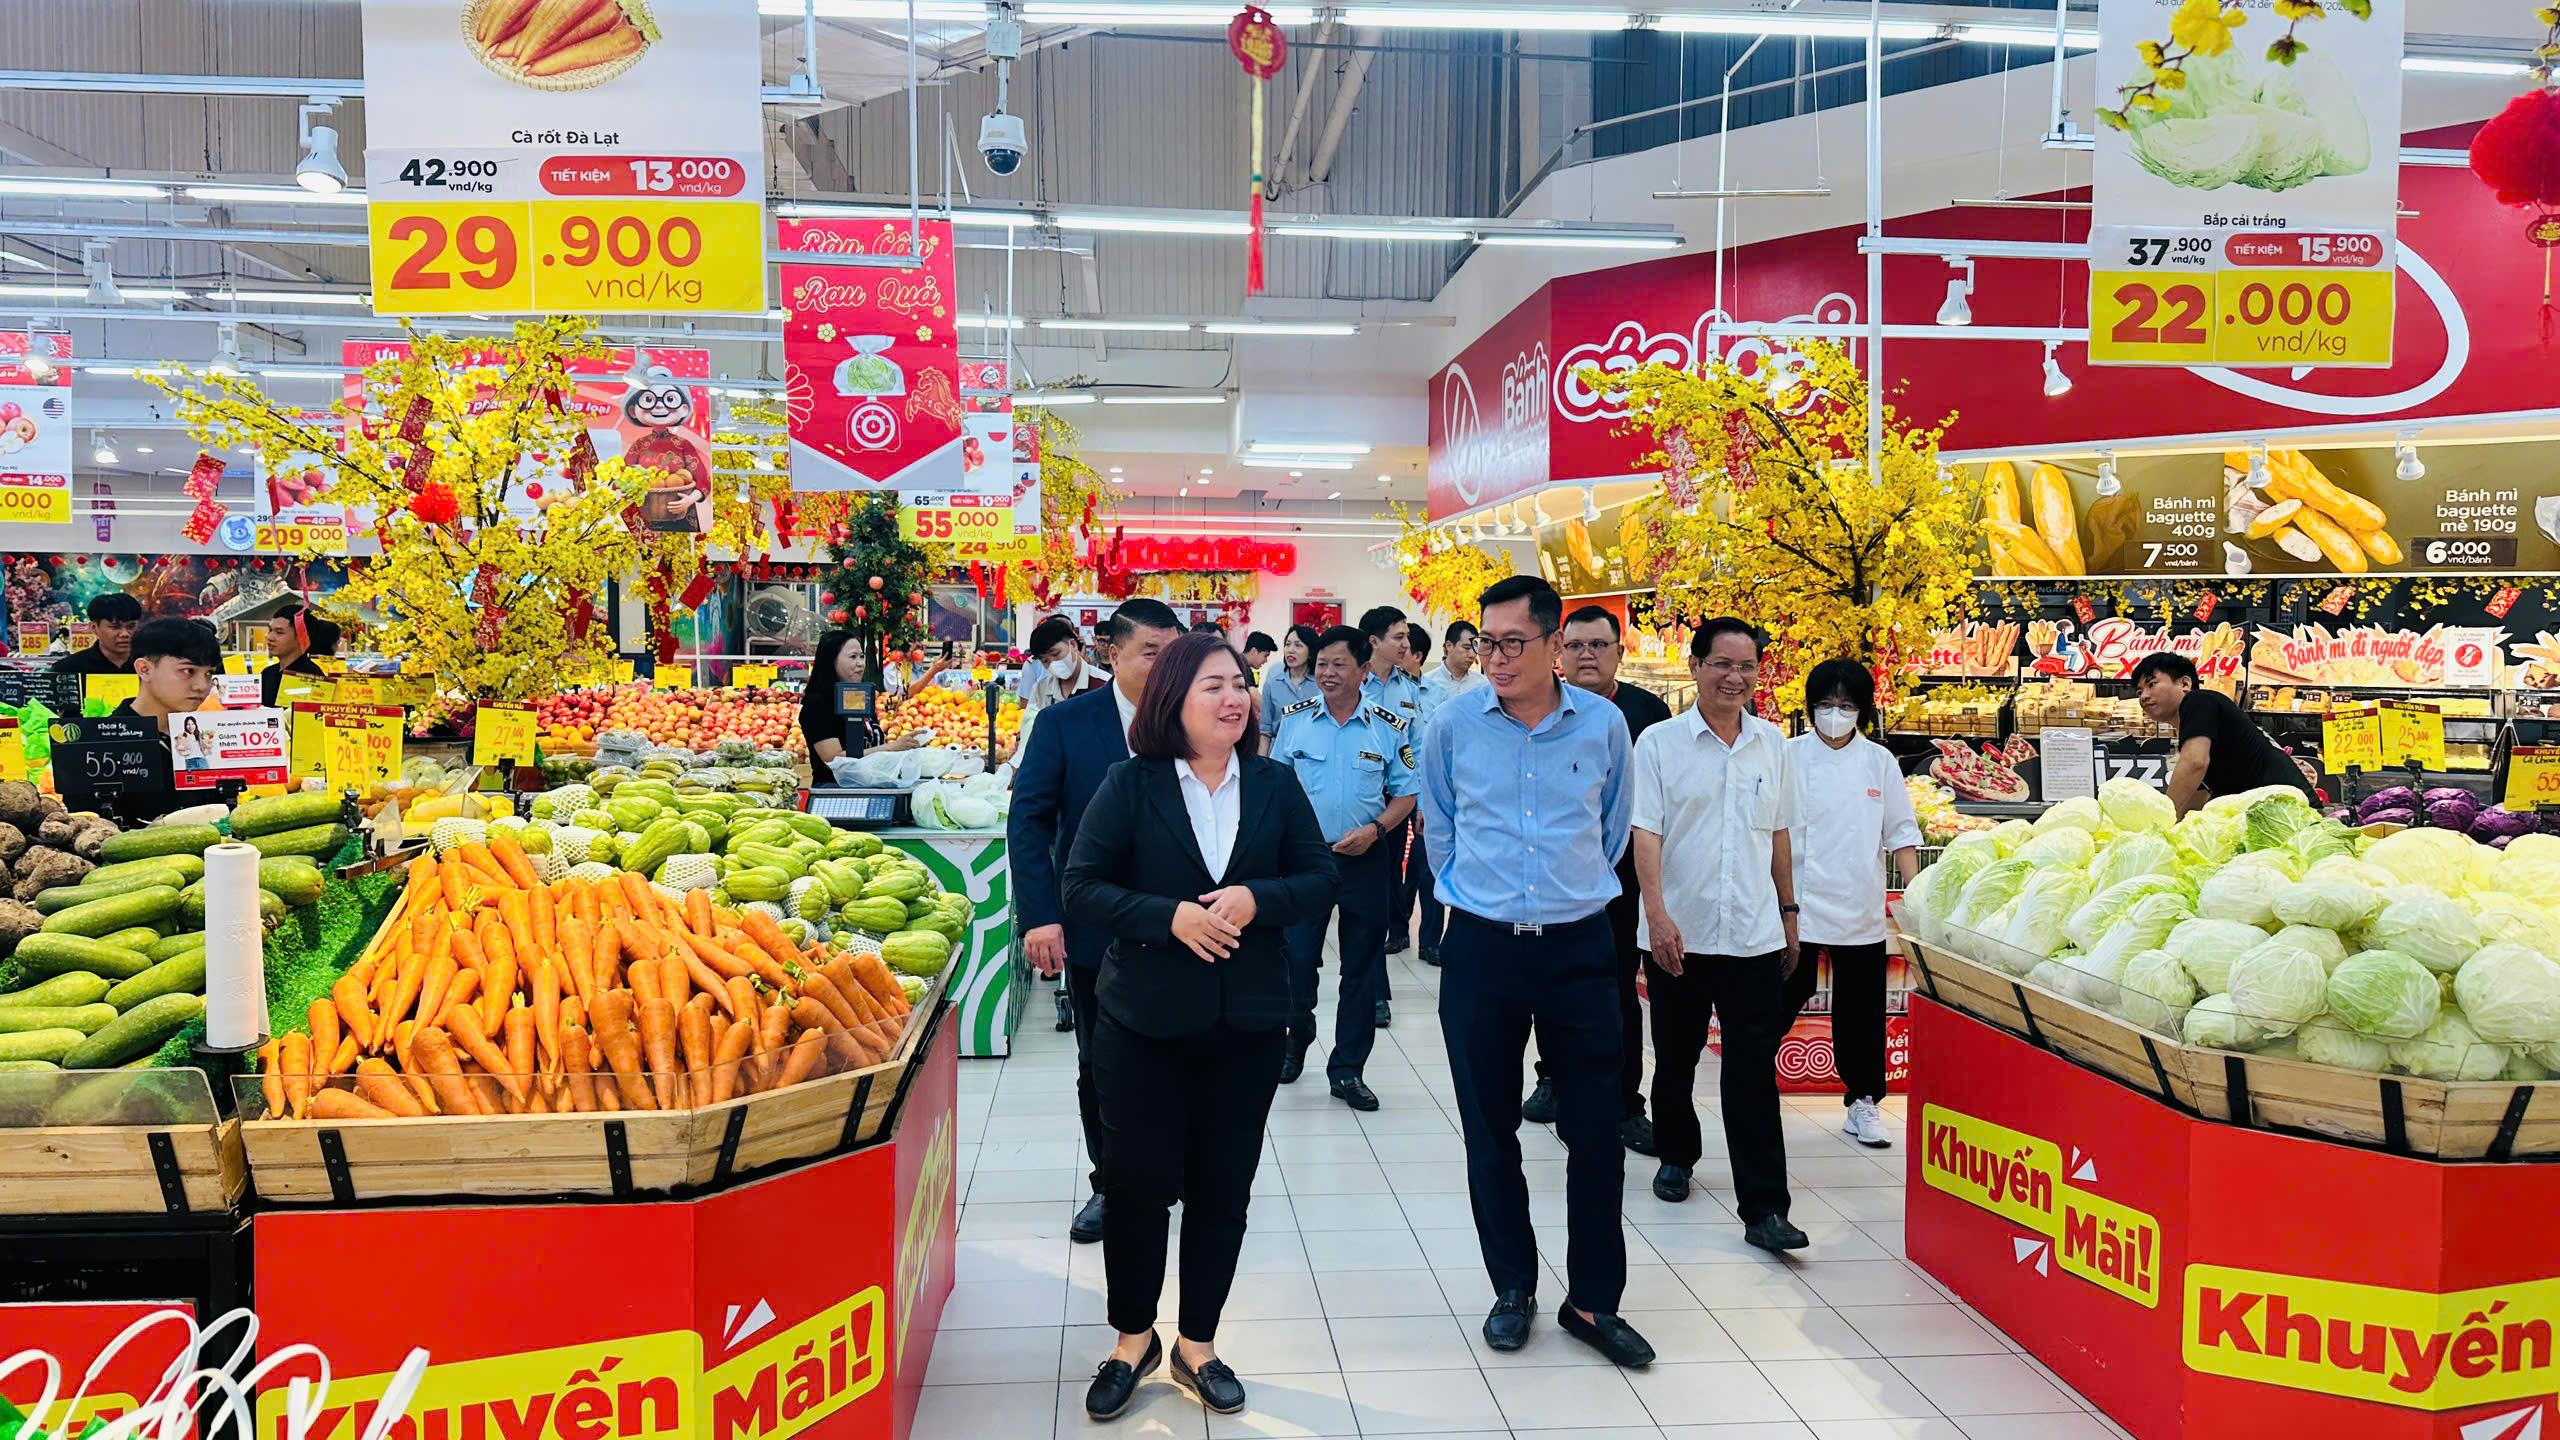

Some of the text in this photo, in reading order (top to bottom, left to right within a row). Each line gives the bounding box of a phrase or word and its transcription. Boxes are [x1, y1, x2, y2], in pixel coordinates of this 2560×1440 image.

[511, 131, 620, 147] Cà rốt Đà Lạt
[551, 167, 578, 182] TIẾT
[580, 168, 610, 184] KIỆM
[448, 181, 493, 193] vnd/kg
[679, 181, 722, 195] vnd/kg
[2203, 213, 2227, 227] Bắp
[2253, 213, 2287, 228] trắng
[2234, 243, 2256, 255] TIẾT
[2257, 243, 2282, 256] KIỆM
[2171, 254, 2205, 265] vnd/kg
[2332, 255, 2364, 266] vnd/kg
[586, 271, 703, 303] vnd/kg
[796, 275, 942, 315] Rau Quả
[2257, 328, 2347, 356] vnd/kg
[1503, 352, 1547, 427] Bánh
[2446, 487, 2518, 502] Bánh mì
[2153, 495, 2216, 510] Bánh mì
[2146, 511, 2216, 525] baguette
[2436, 504, 2518, 519] baguette
[2172, 524, 2215, 538] 400g
[2472, 518, 2517, 533] 190g
[2447, 555, 2492, 564] vnd/bánh
[2092, 618, 2203, 658] Bánh mì
[2283, 639, 2325, 671] Bánh
[2330, 637, 2348, 660] mì
[2351, 632, 2370, 659] đi
[2371, 634, 2412, 666] người
[320, 703, 377, 715] KHUYẾN MÃI
[239, 731, 280, 746] 10%
[2093, 750, 2172, 788] izz
[1926, 1117, 2153, 1295] Khuyến Mãi!
[2198, 1285, 2553, 1394] Khuyến
[713, 1304, 874, 1440] Mãi!
